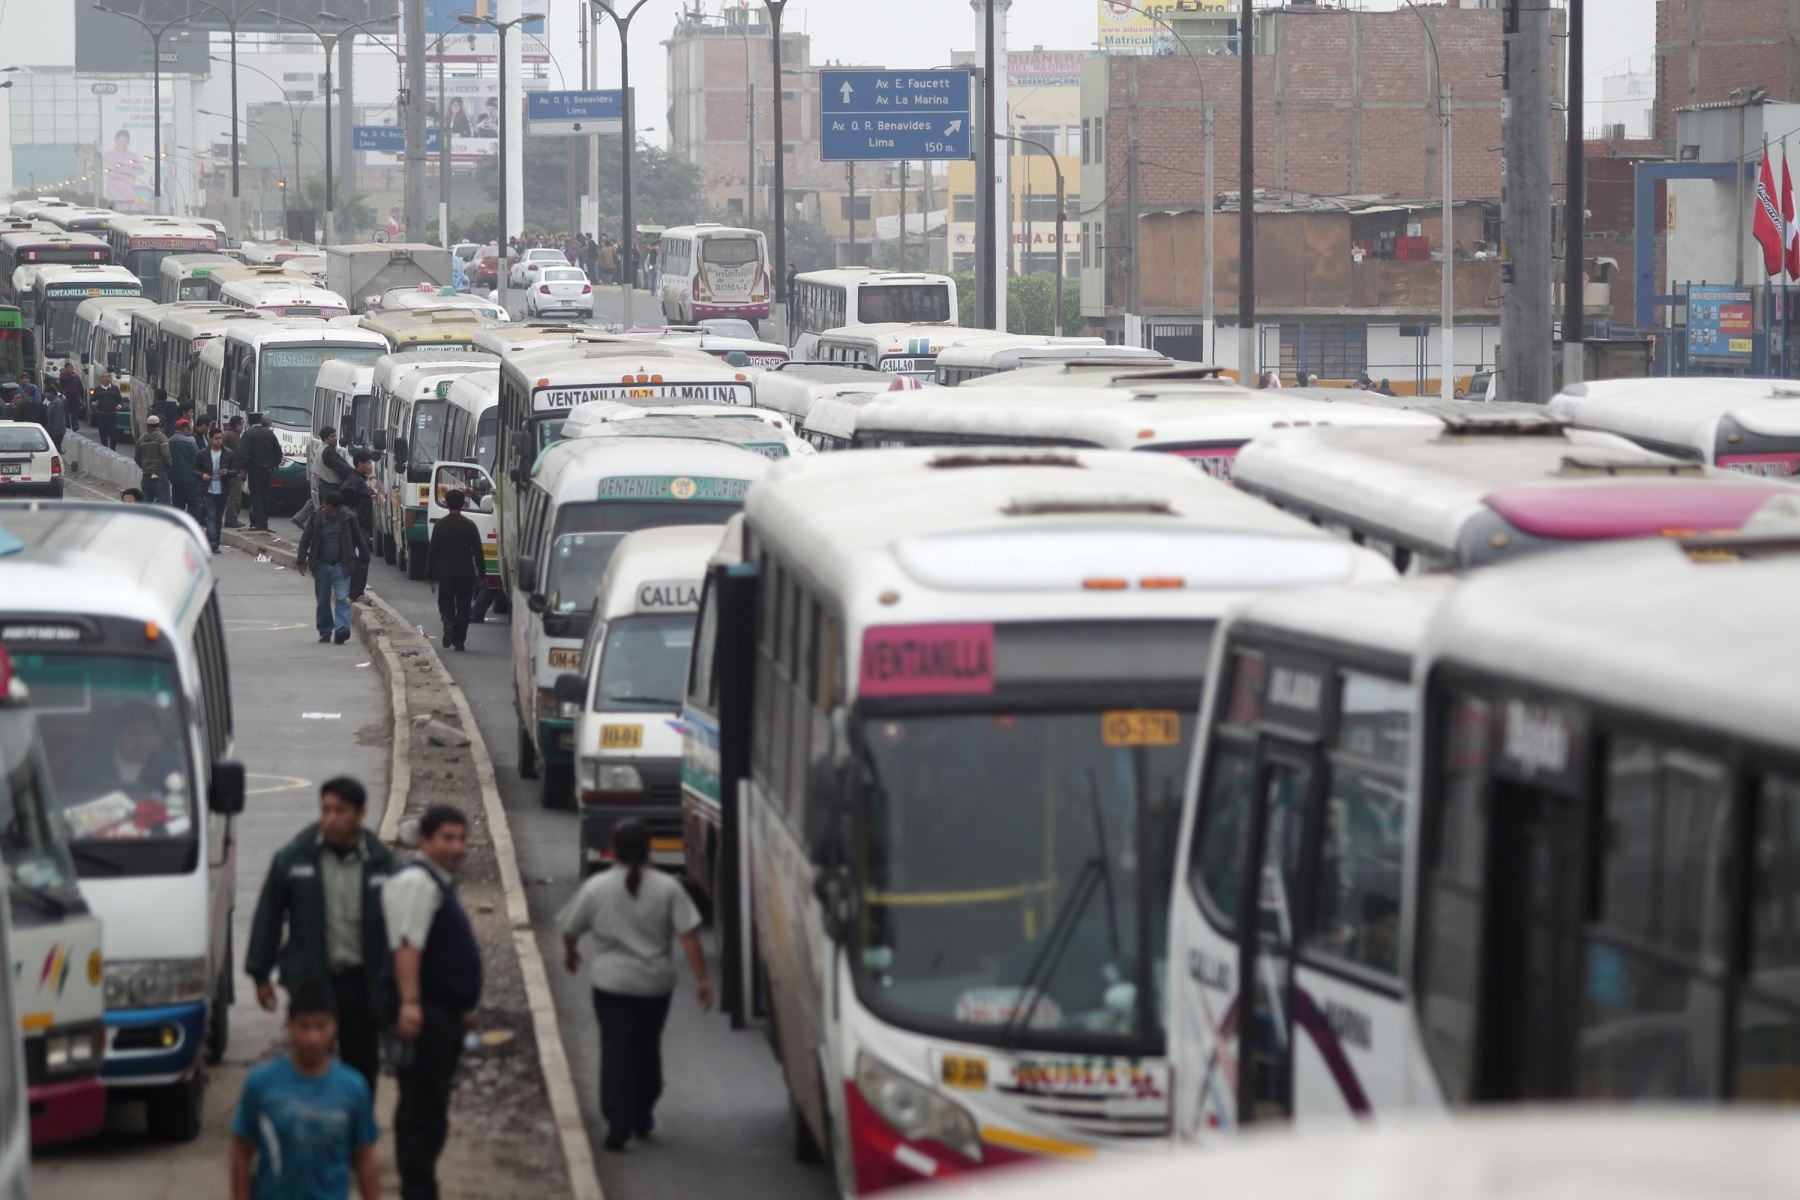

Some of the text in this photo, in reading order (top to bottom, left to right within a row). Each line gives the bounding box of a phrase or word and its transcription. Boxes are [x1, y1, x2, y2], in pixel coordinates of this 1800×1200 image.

[875, 79, 951, 89] Av. E. Faucett
[574, 96, 613, 104] Benavides
[875, 95, 949, 105] Av. La Marina
[566, 107, 586, 115] Lima
[832, 122, 845, 131] Av.
[864, 121, 873, 131] R.
[878, 120, 931, 131] Benavides
[868, 138, 895, 147] Lima
[924, 142, 943, 152] 150
[882, 360, 913, 372] CALLAO
[546, 389, 627, 407] VENTANILLA
[661, 387, 677, 399] LA
[681, 386, 738, 405] MOLINA
[601, 479, 667, 496] VENTANILLA
[640, 586, 699, 607] CALLA
[865, 639, 991, 681] VENTANILLA
